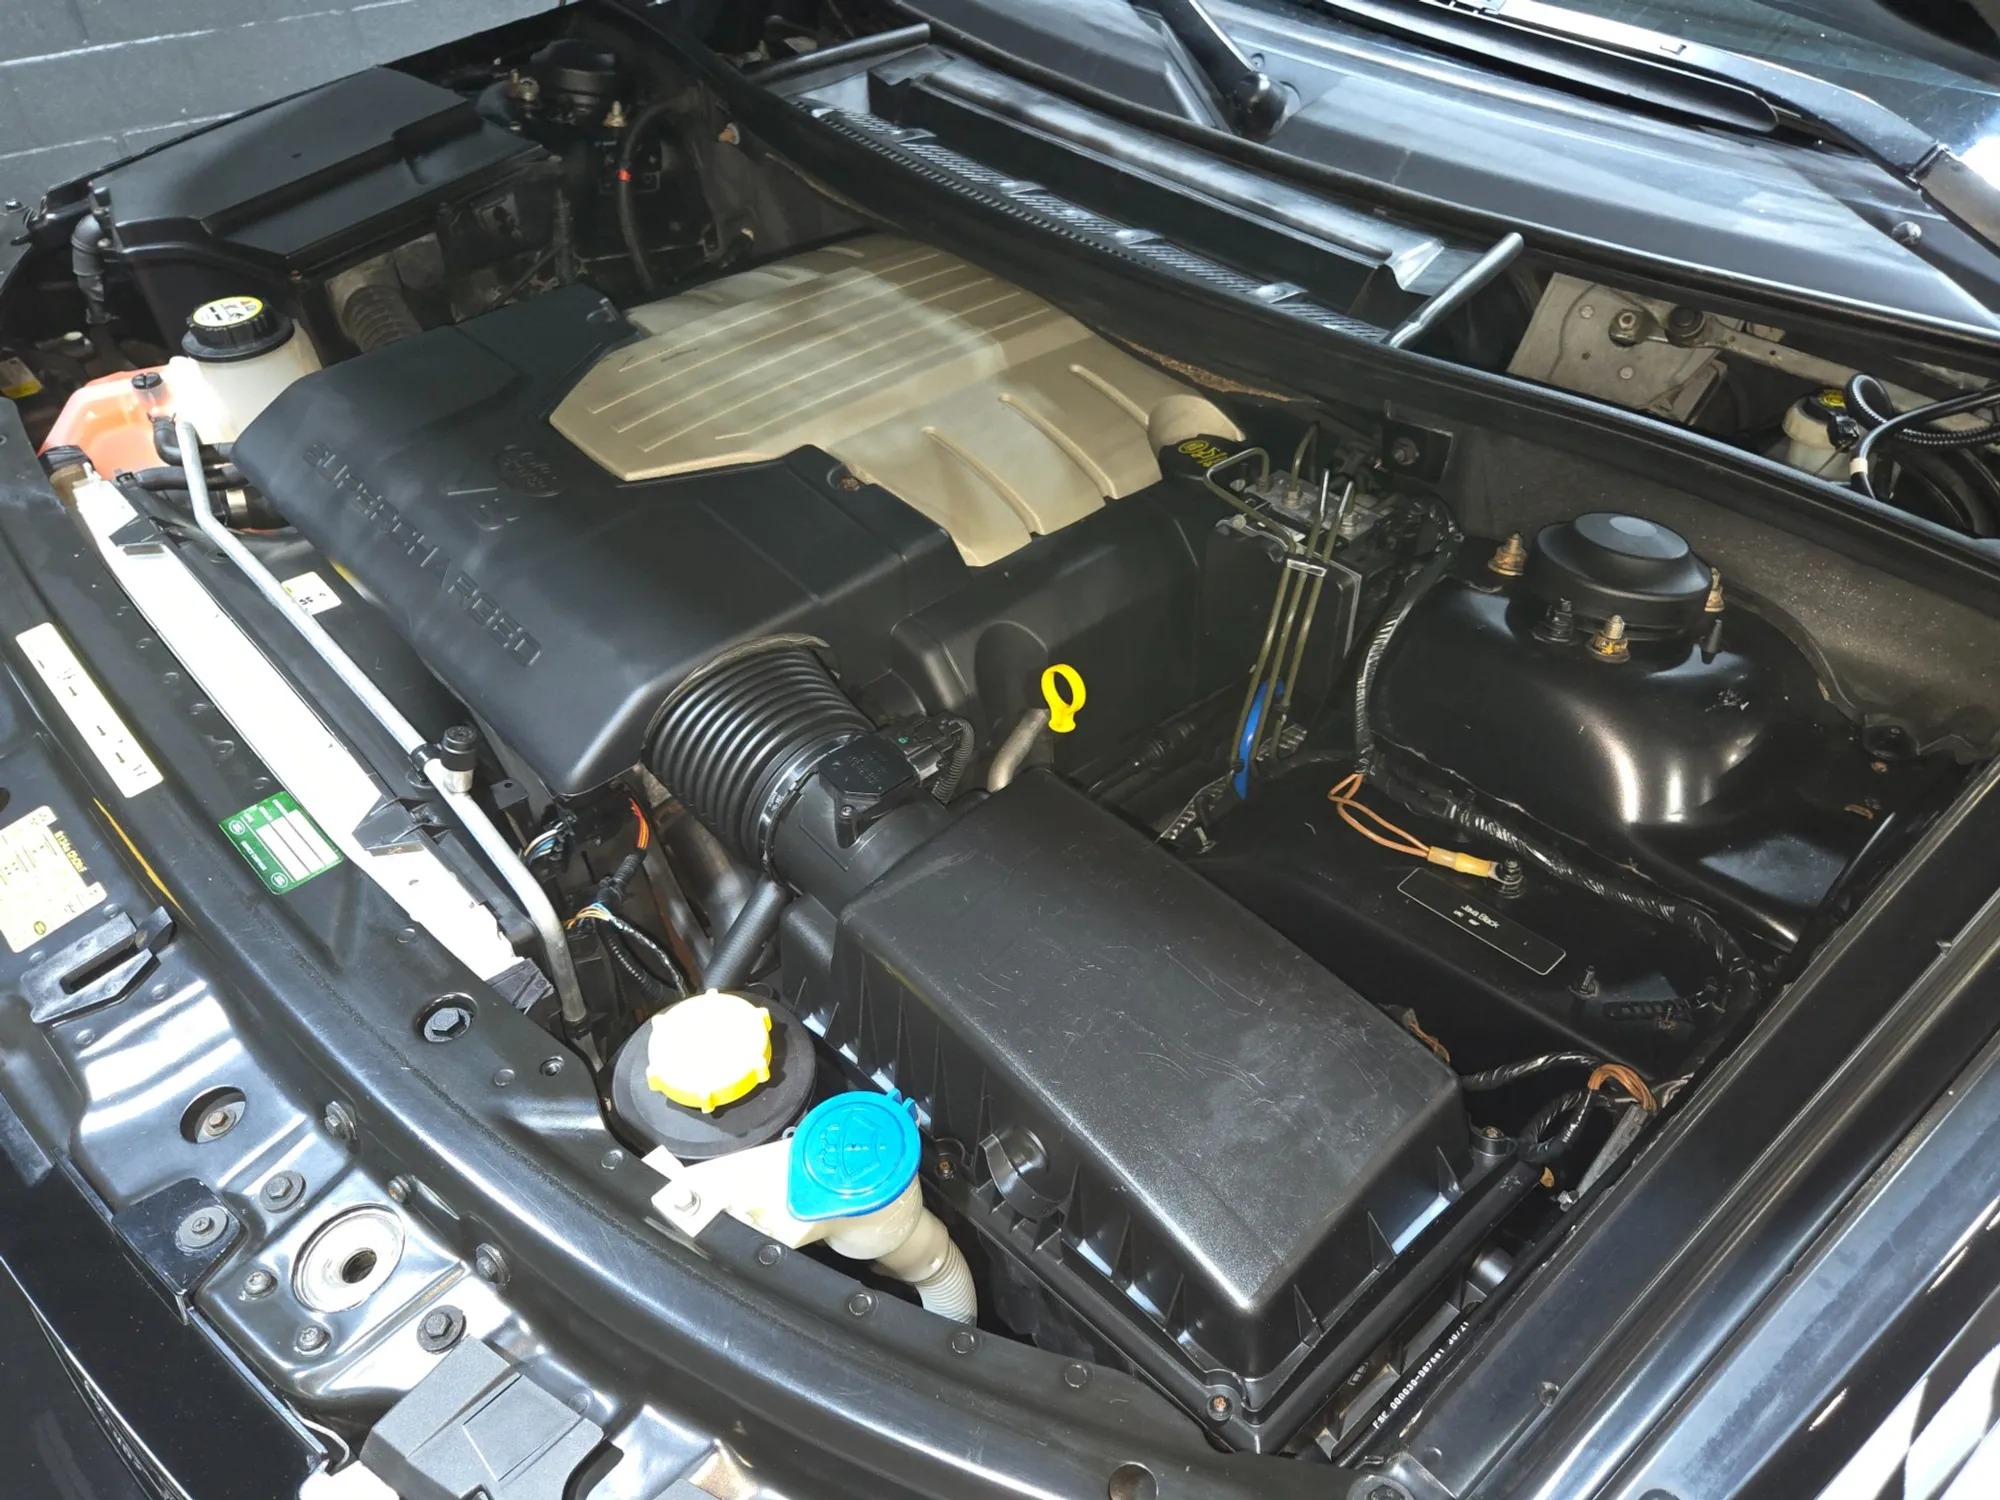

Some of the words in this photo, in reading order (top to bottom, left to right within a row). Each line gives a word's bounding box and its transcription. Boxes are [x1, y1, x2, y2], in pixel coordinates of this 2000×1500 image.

[303, 443, 543, 667] SUPERCHARGED
[1461, 904, 1480, 917] Java
[1479, 912, 1500, 929] Black
